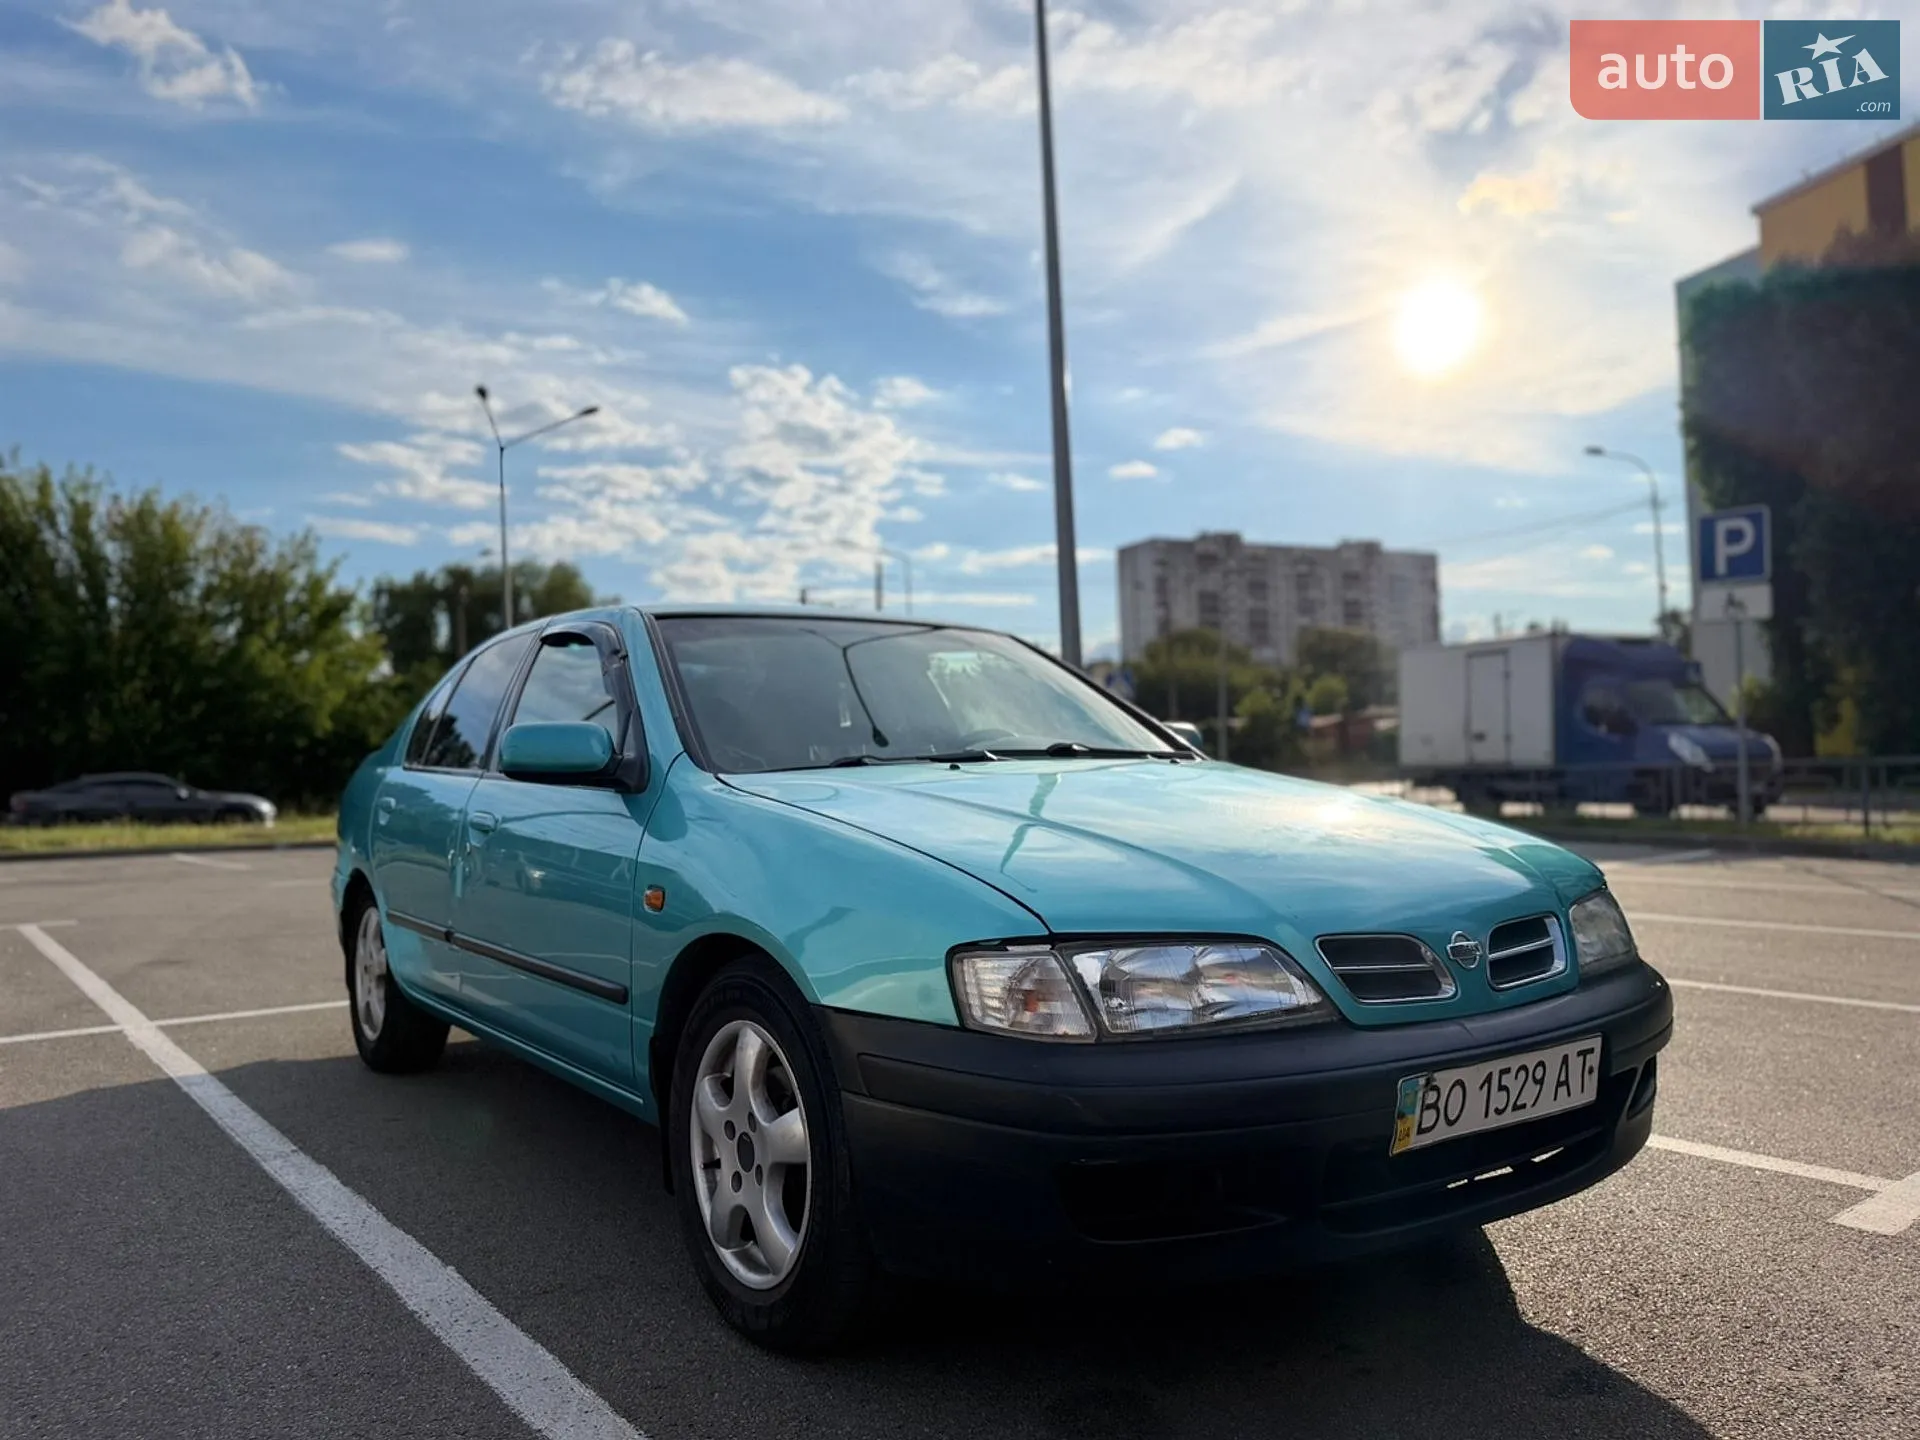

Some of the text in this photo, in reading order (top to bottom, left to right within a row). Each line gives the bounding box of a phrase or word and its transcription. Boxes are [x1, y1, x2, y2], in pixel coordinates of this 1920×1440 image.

[1714, 516, 1756, 576] P
[1416, 1047, 1595, 1135] BO 1529 AT
